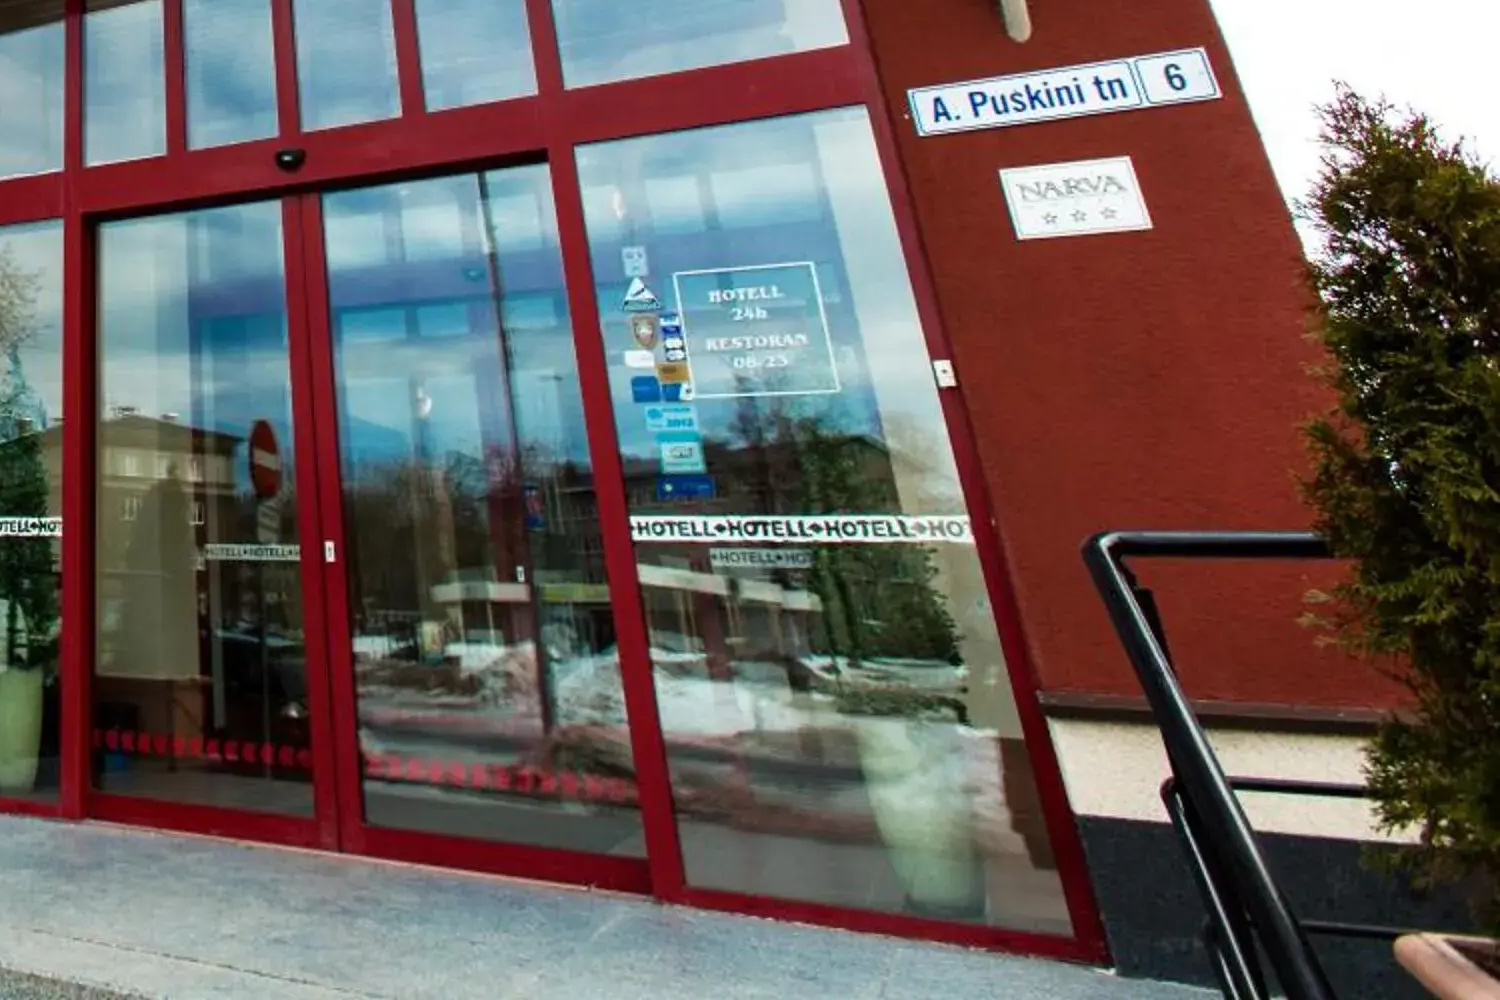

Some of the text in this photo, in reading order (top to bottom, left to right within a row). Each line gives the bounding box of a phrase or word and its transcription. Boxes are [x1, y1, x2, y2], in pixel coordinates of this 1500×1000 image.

[932, 63, 1187, 123] A. Puskini tn 6
[1015, 174, 1129, 201] NARVA
[707, 285, 785, 303] HOTELL
[730, 305, 768, 321] 24h
[705, 333, 808, 351] RESTORAN
[637, 520, 716, 537] HOTELL
[727, 519, 813, 537] HOTELL
[824, 520, 916, 538] HOTELL
[719, 551, 776, 564] HOTELL
